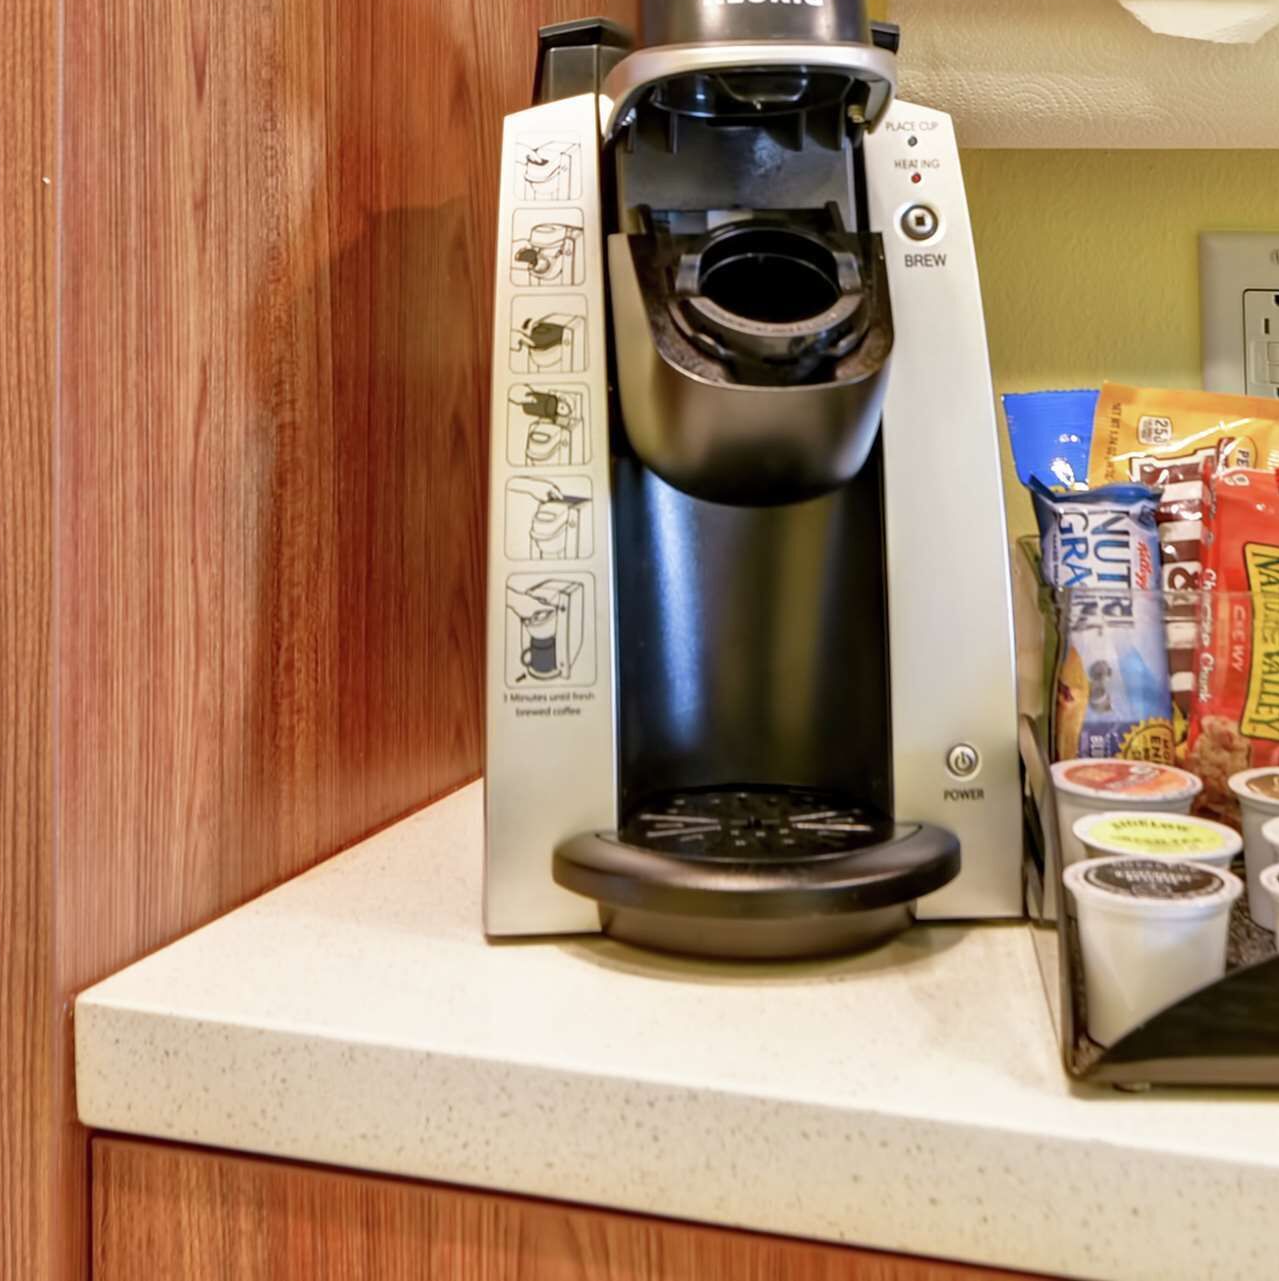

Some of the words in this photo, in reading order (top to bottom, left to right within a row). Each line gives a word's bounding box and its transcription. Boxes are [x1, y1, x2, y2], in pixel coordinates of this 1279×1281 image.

[885, 122, 915, 131] PLACE
[919, 122, 939, 131] CUP
[894, 159, 940, 169] HEATING
[904, 253, 946, 268] BREW
[1091, 508, 1135, 629] NUTRI
[1135, 541, 1154, 592] Kellogg
[510, 691, 547, 702] Minutes
[572, 691, 595, 701] fresh
[553, 705, 581, 716] coffee
[943, 788, 985, 800] POWER
